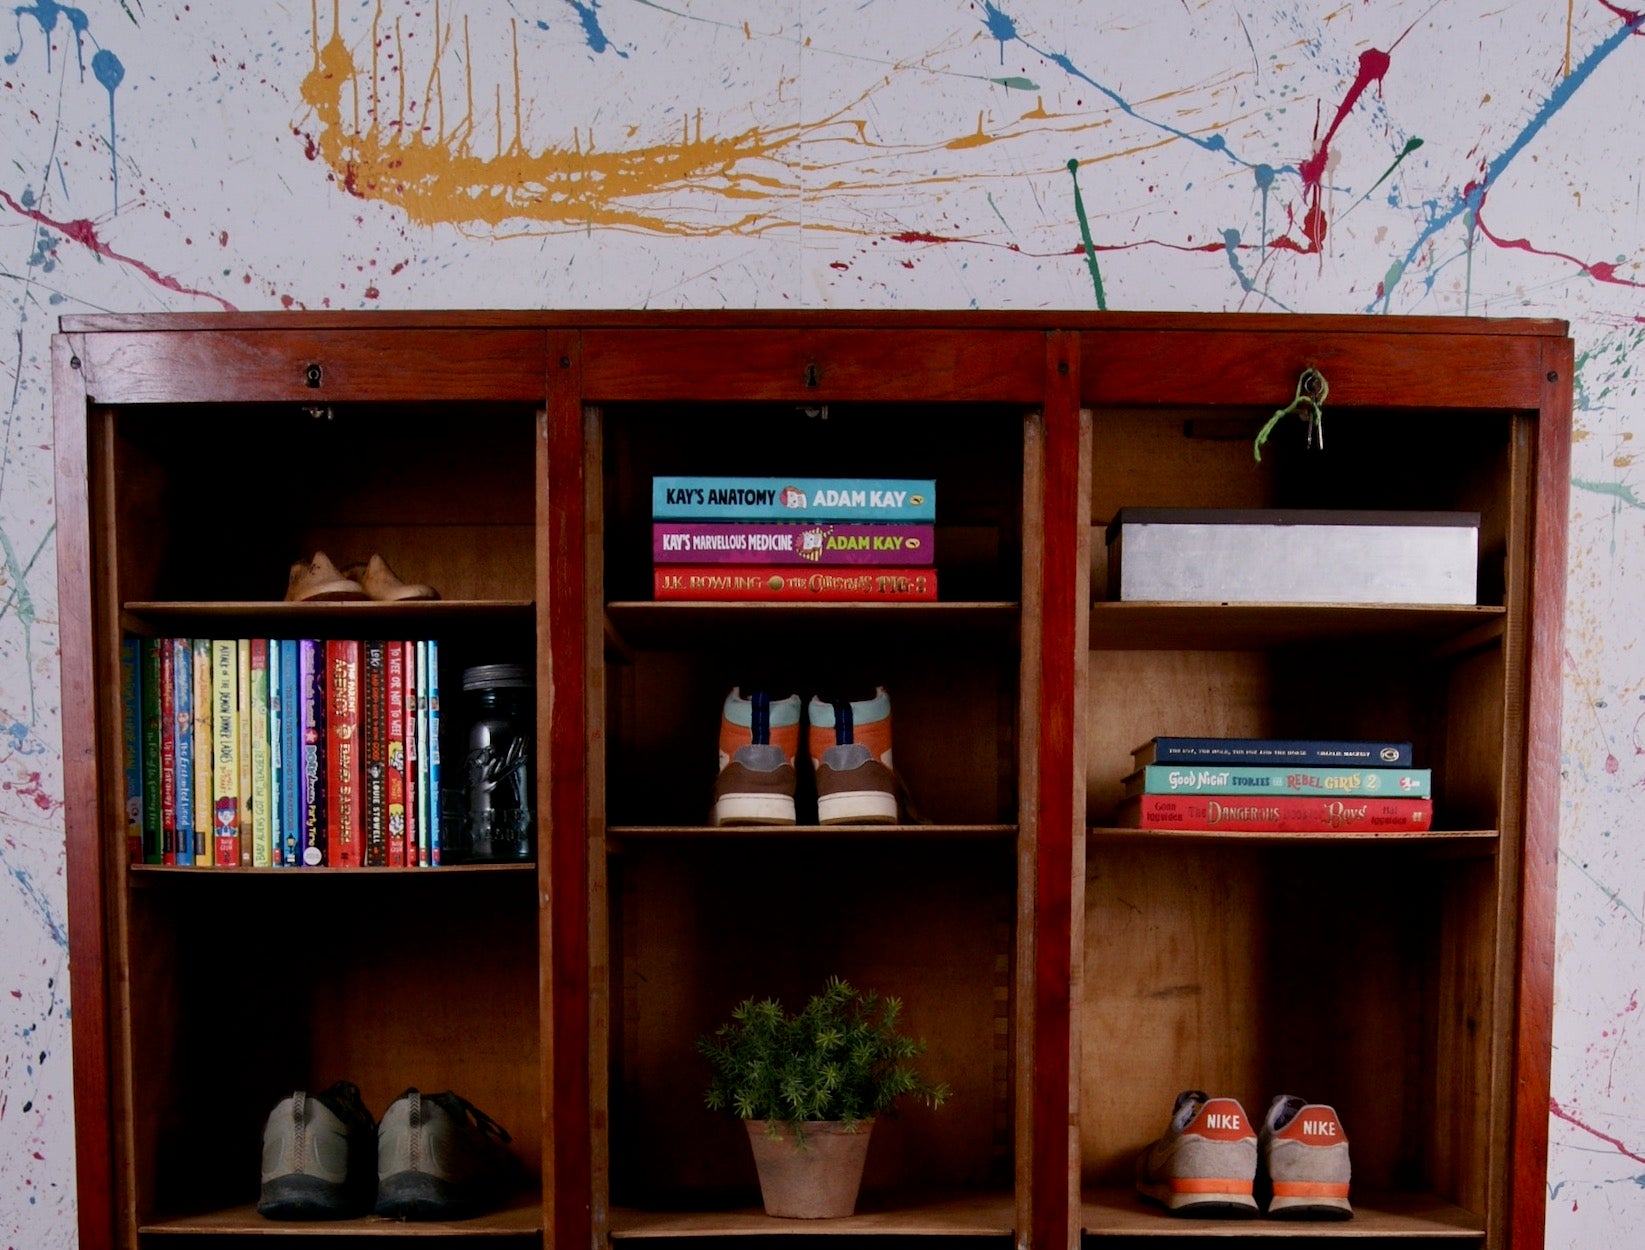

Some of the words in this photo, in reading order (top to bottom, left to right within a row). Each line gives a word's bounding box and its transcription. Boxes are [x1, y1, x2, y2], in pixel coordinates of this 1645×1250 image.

[666, 488, 705, 505] KAY'S
[707, 489, 776, 506] ANATOMY
[812, 490, 866, 507] ADAM
[869, 490, 908, 508] KAY
[662, 533, 691, 551] KAY'S
[692, 534, 748, 551] MARVELLOUS
[748, 533, 794, 551] MEDICINE
[825, 535, 870, 551] ADAM
[873, 536, 905, 551] KAY
[661, 575, 687, 590] J.K.
[689, 575, 763, 590] ROWLING
[807, 573, 873, 594] CHRISTMAS
[219, 645, 231, 668] ATTACK
[347, 662, 356, 681] THE
[390, 658, 402, 675] WEE
[334, 658, 348, 717] AGENCY
[390, 676, 402, 689] OR
[219, 691, 231, 714] DEMON
[347, 681, 357, 714] PARENT
[390, 690, 402, 706] NOT
[219, 715, 232, 738] DINNER
[219, 740, 234, 763] LADIES
[163, 766, 174, 807] Faraway
[1232, 776, 1270, 787] STORIES
[1286, 773, 1323, 791] REBEL
[1366, 774, 1377, 789] 2
[254, 786, 264, 797] MY
[372, 780, 381, 804] LOUIE
[254, 800, 265, 815] GOT
[306, 804, 317, 827] Party
[164, 808, 173, 826] Tree
[372, 806, 382, 845] STOWELL
[255, 817, 265, 841] ALIENS
[255, 843, 266, 861] BABY
[1206, 1113, 1241, 1130] NIKE
[1303, 1120, 1336, 1136] NIKE
